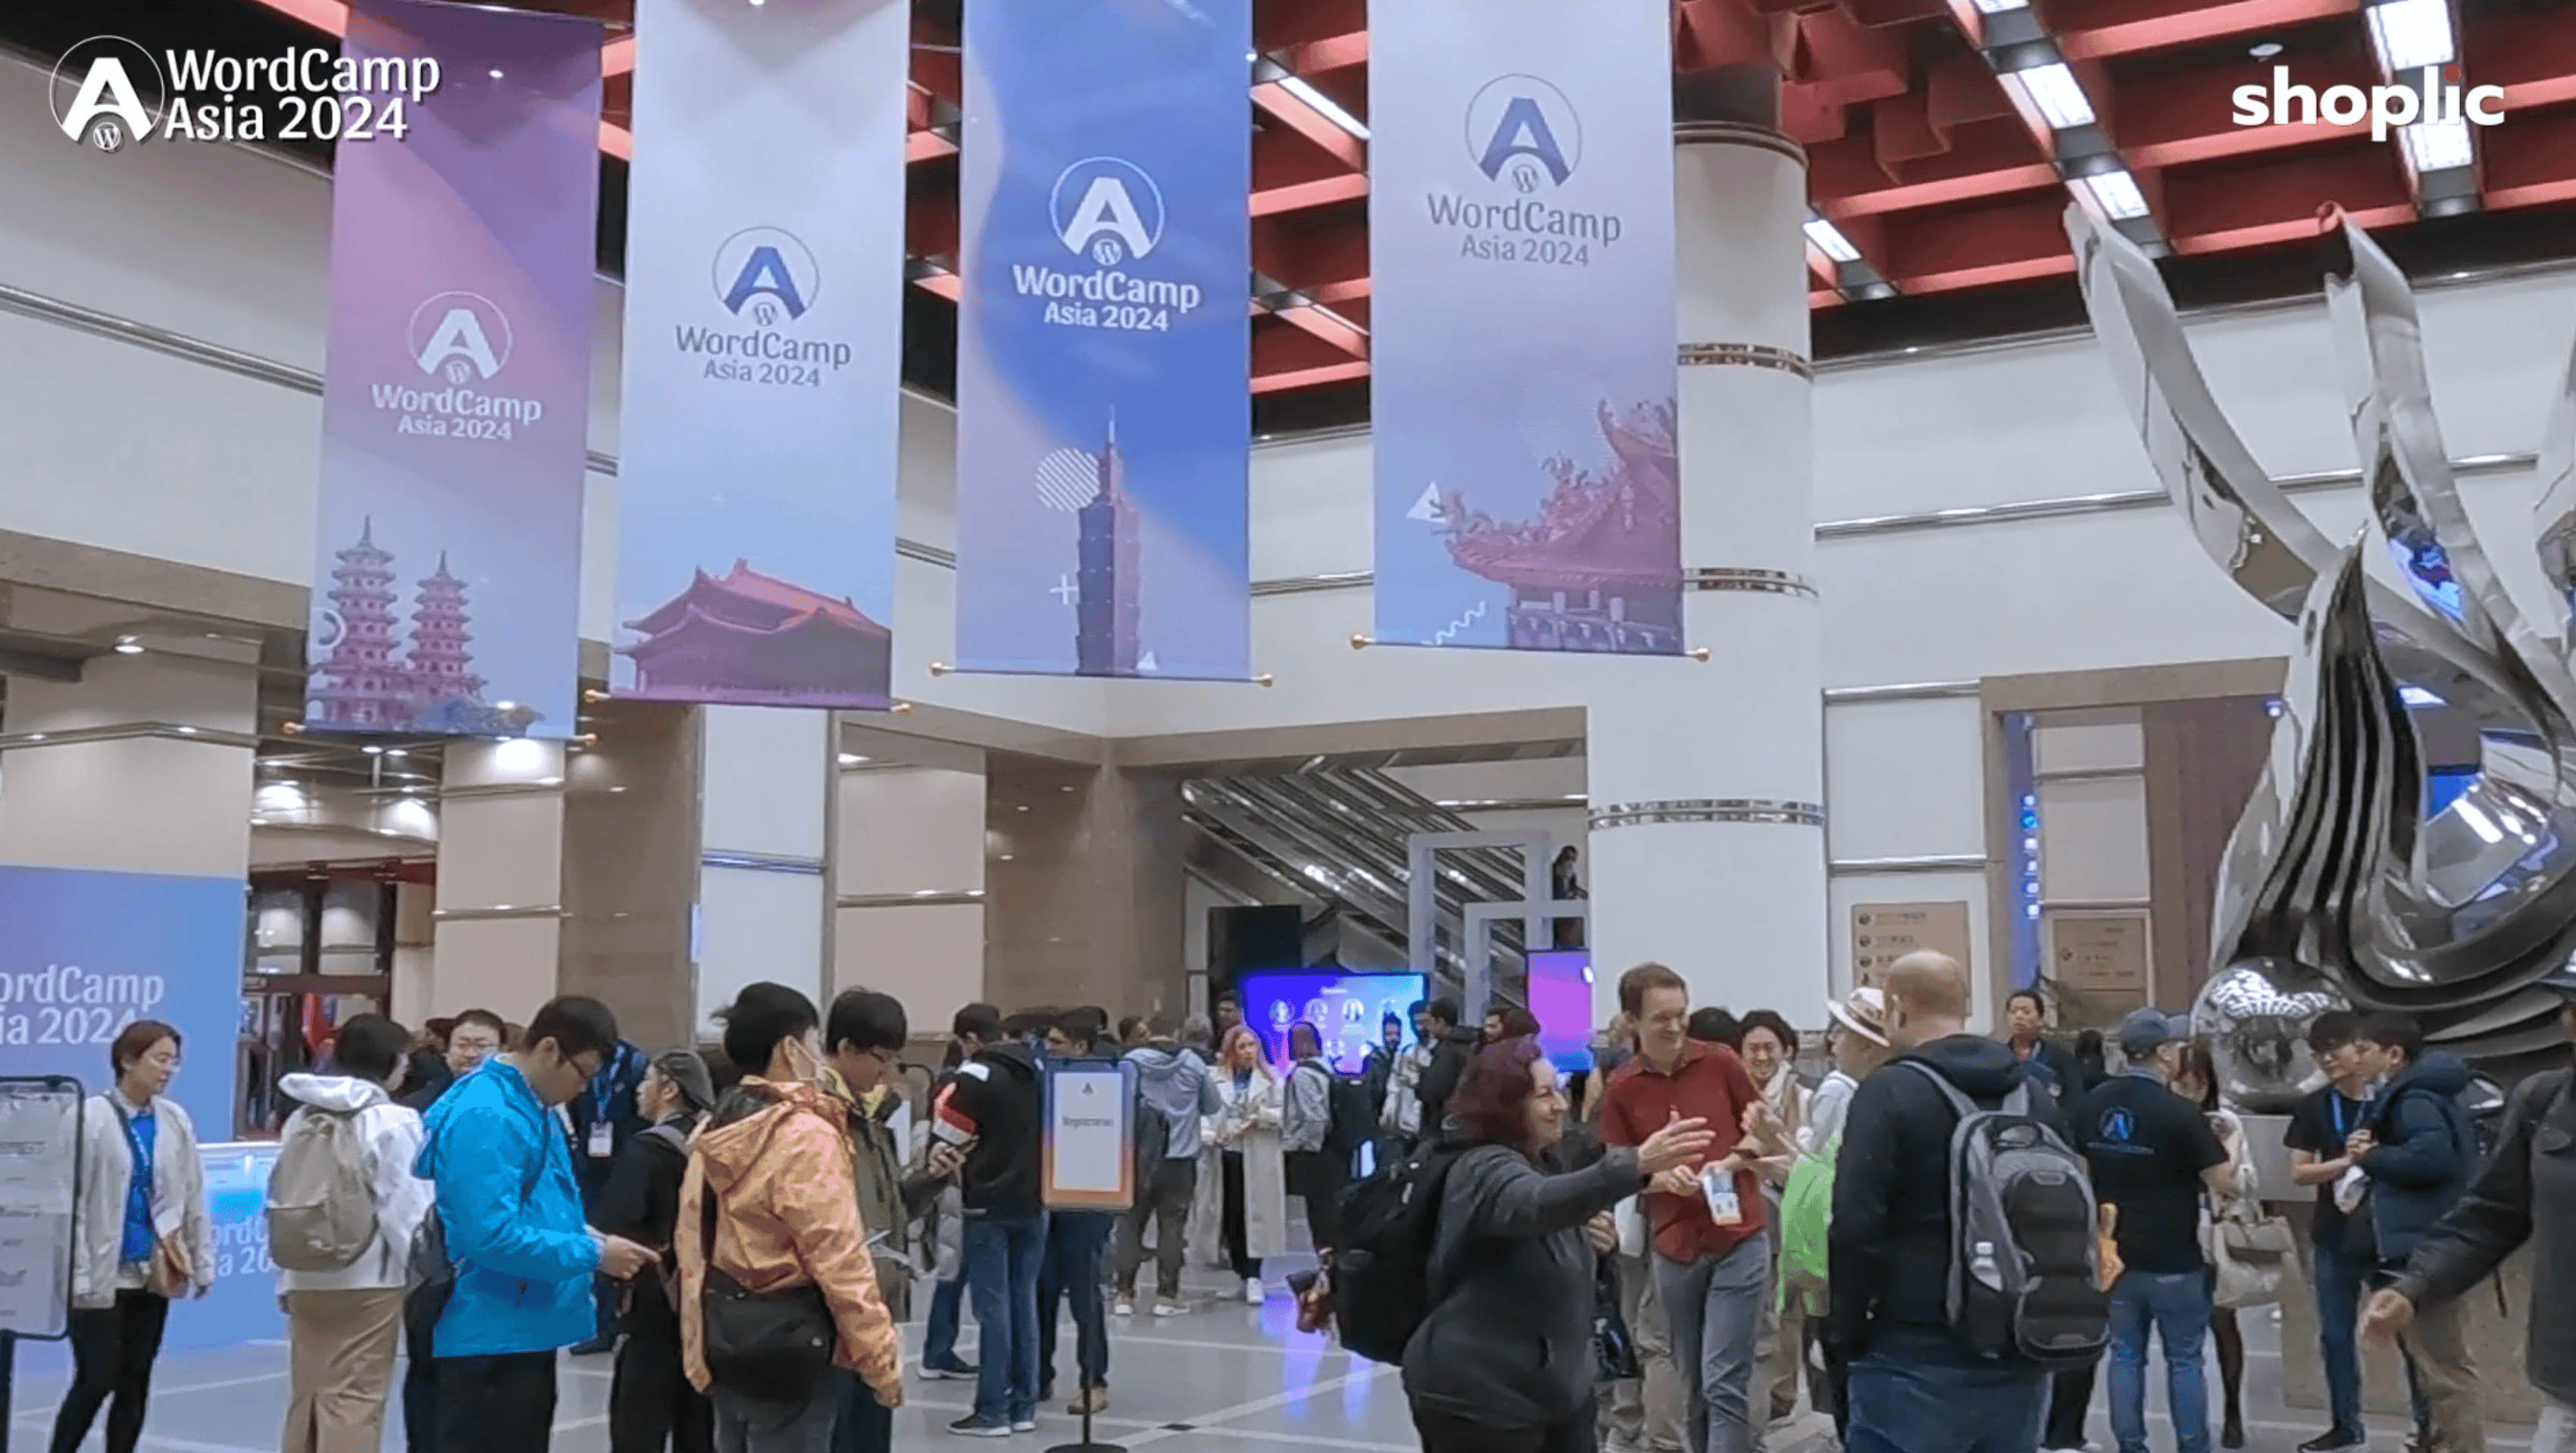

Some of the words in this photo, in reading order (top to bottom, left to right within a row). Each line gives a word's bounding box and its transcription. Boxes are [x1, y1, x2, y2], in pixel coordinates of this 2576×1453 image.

[1427, 192, 1621, 248] WordCamp
[1461, 233, 1515, 261] Asia
[1523, 238, 1590, 267] 2024
[1012, 264, 1201, 314] WordCamp
[1043, 301, 1097, 327] Asia
[1101, 305, 1169, 332] 2024
[676, 324, 852, 370] WordCamp
[704, 359, 752, 382] Asia
[759, 362, 820, 387] 2024
[371, 383, 542, 426] WordCamp
[398, 414, 447, 436] Asia
[451, 417, 512, 440] 2024
[0, 964, 165, 1013] ordCamp
[0, 1005, 30, 1045] ia
